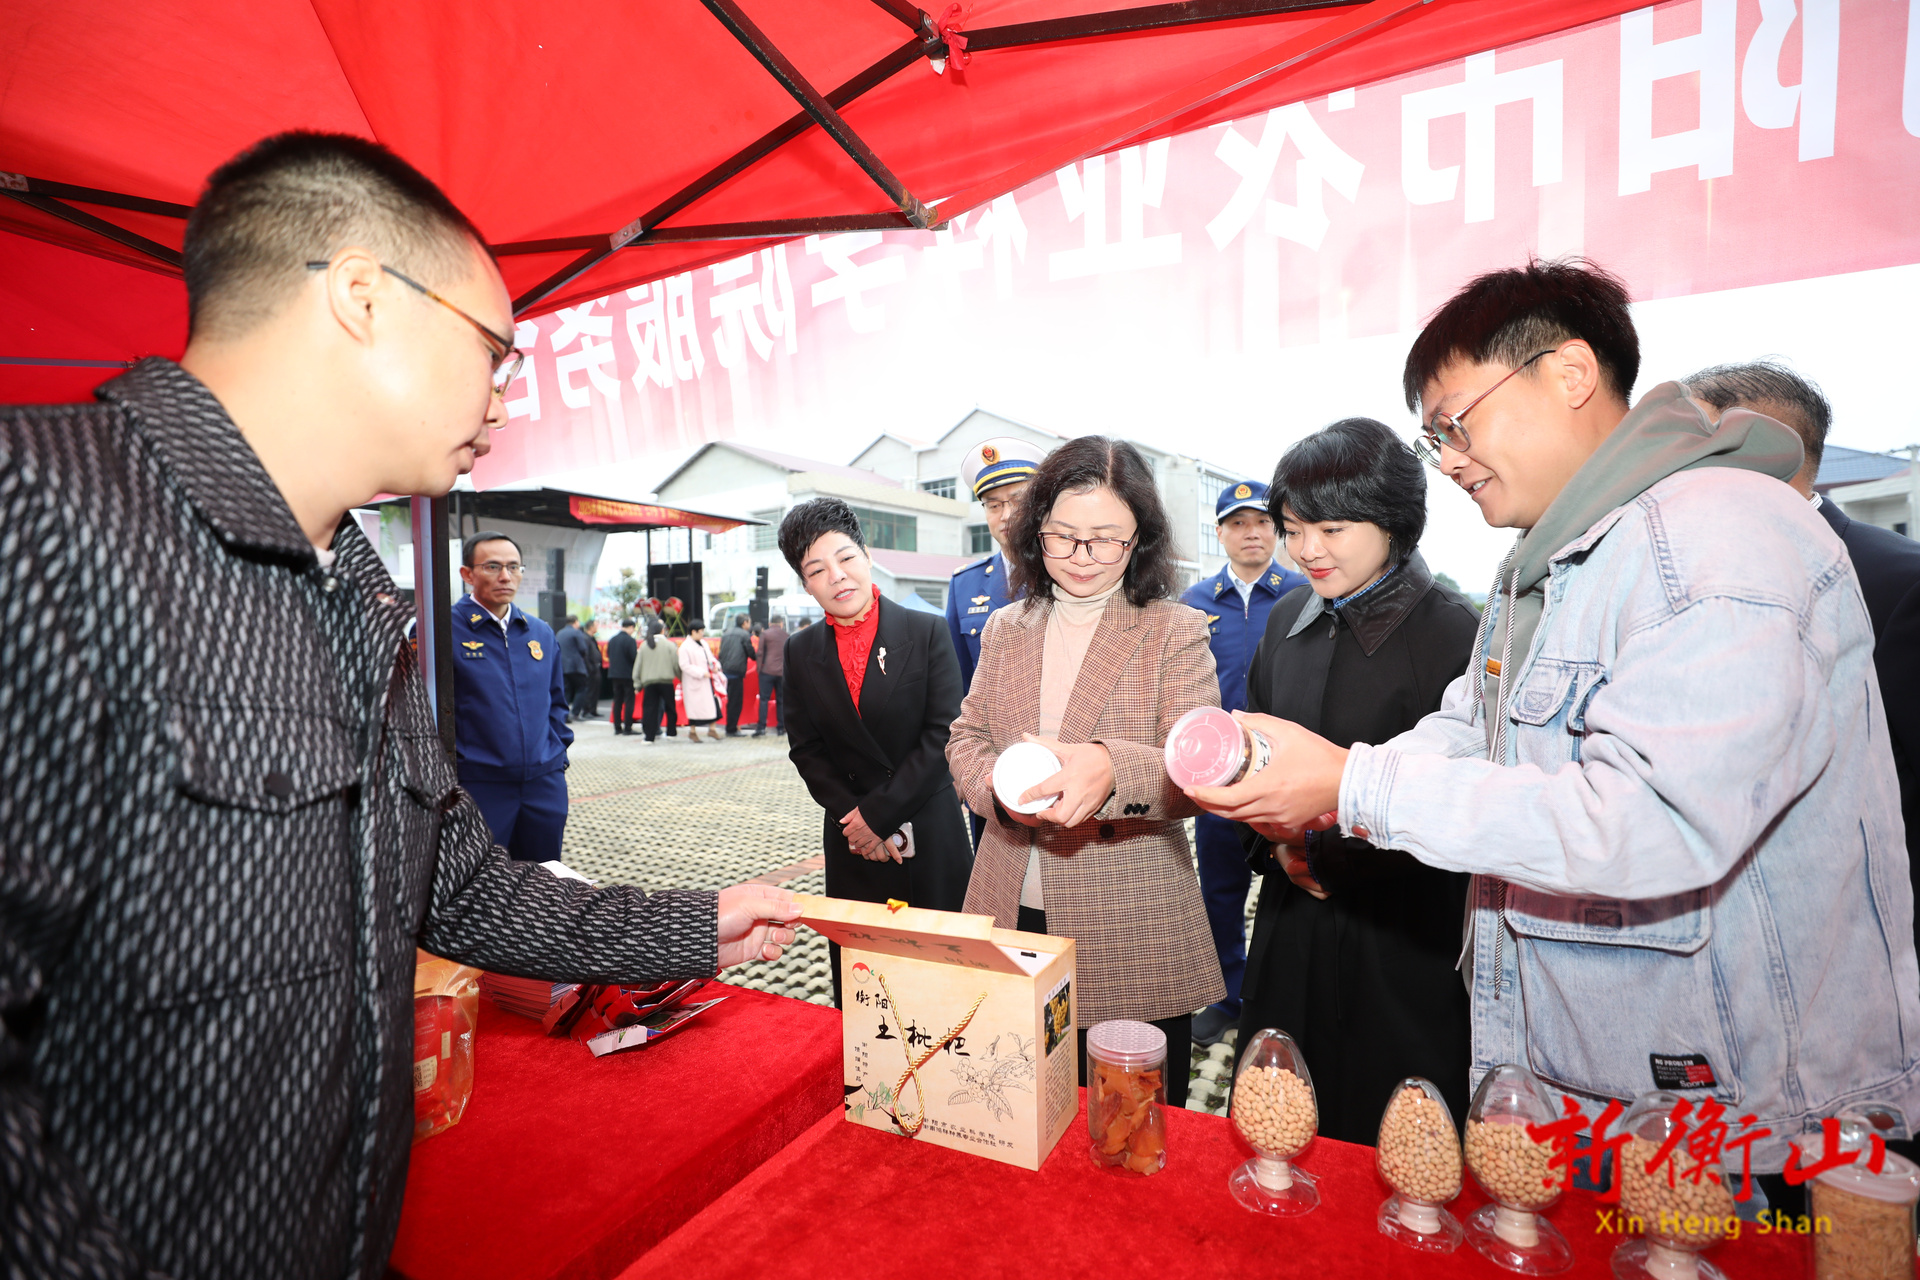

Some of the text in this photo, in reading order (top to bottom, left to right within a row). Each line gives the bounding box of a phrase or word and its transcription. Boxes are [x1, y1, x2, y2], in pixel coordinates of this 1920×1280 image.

[855, 990, 889, 1010] 衡阳
[875, 1014, 971, 1057] 土枇杷
[1679, 1079, 1705, 1088] Sport
